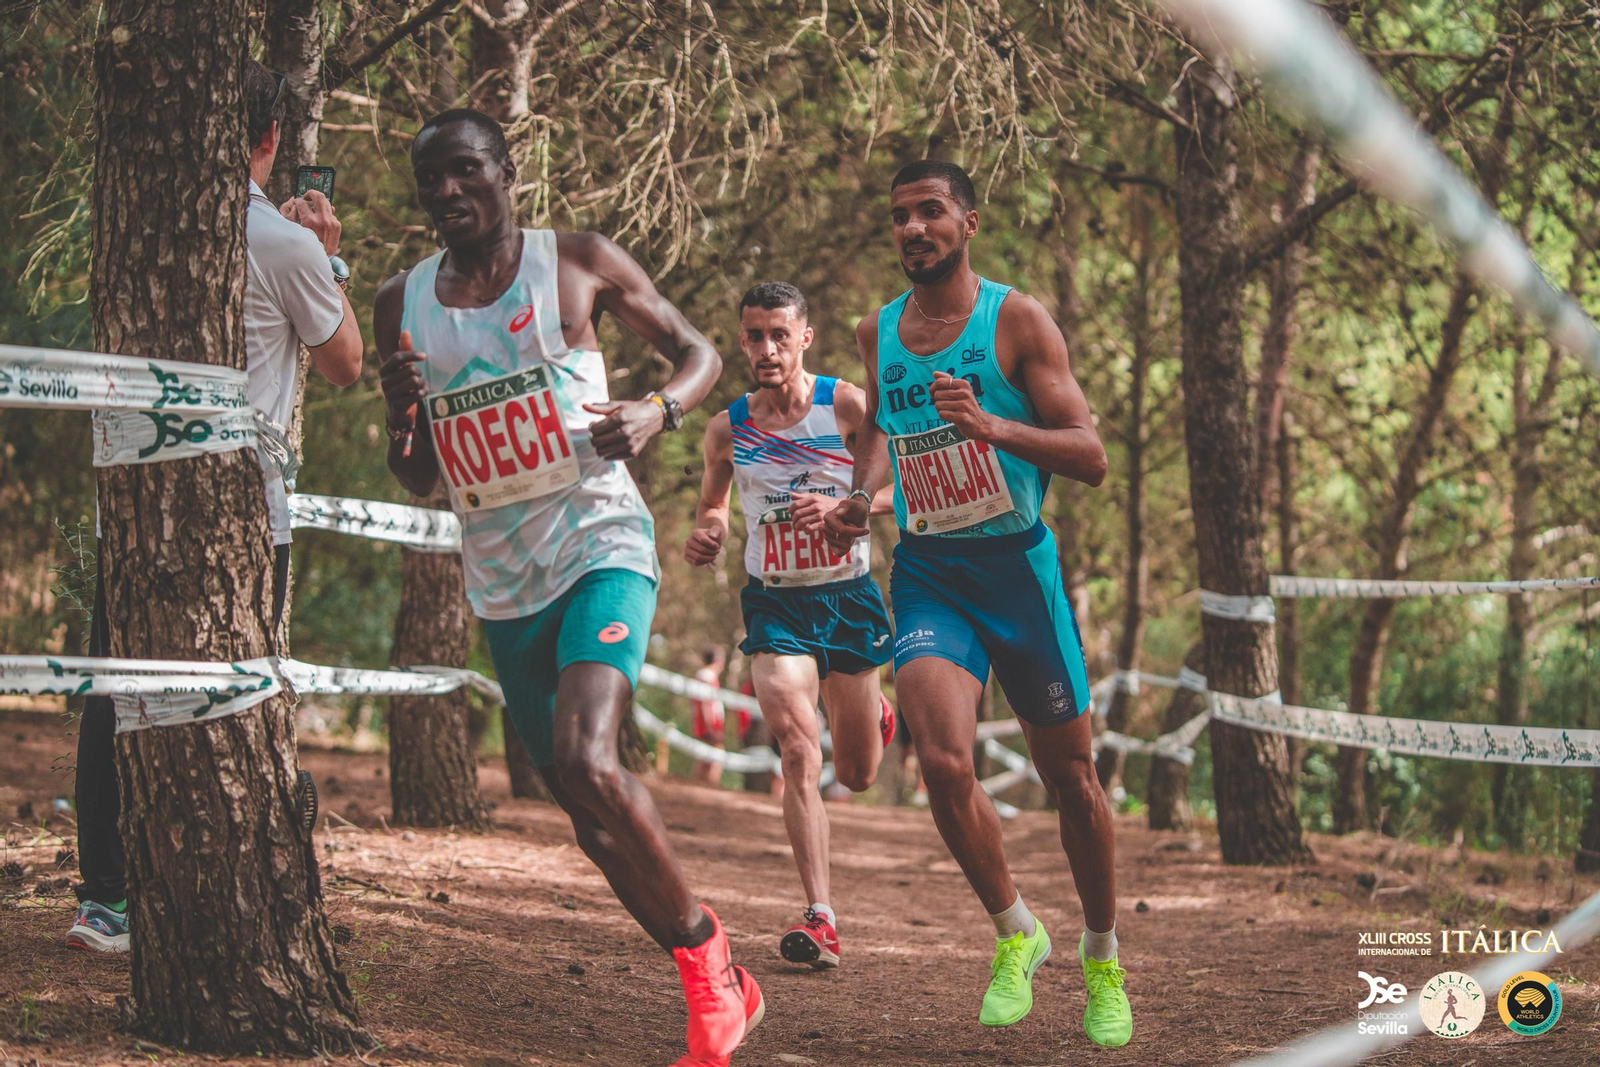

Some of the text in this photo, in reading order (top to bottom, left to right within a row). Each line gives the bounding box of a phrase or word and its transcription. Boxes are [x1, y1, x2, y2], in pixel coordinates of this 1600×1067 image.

[962, 343, 987, 362] als
[884, 366, 906, 382] TROPS
[19, 378, 78, 399] Sevilla
[453, 382, 515, 410] ITÁLICA
[433, 390, 570, 488] KOECH
[909, 430, 957, 452] ITÁLICA
[899, 440, 999, 514] BOUFALJAT
[895, 629, 935, 647] nerja
